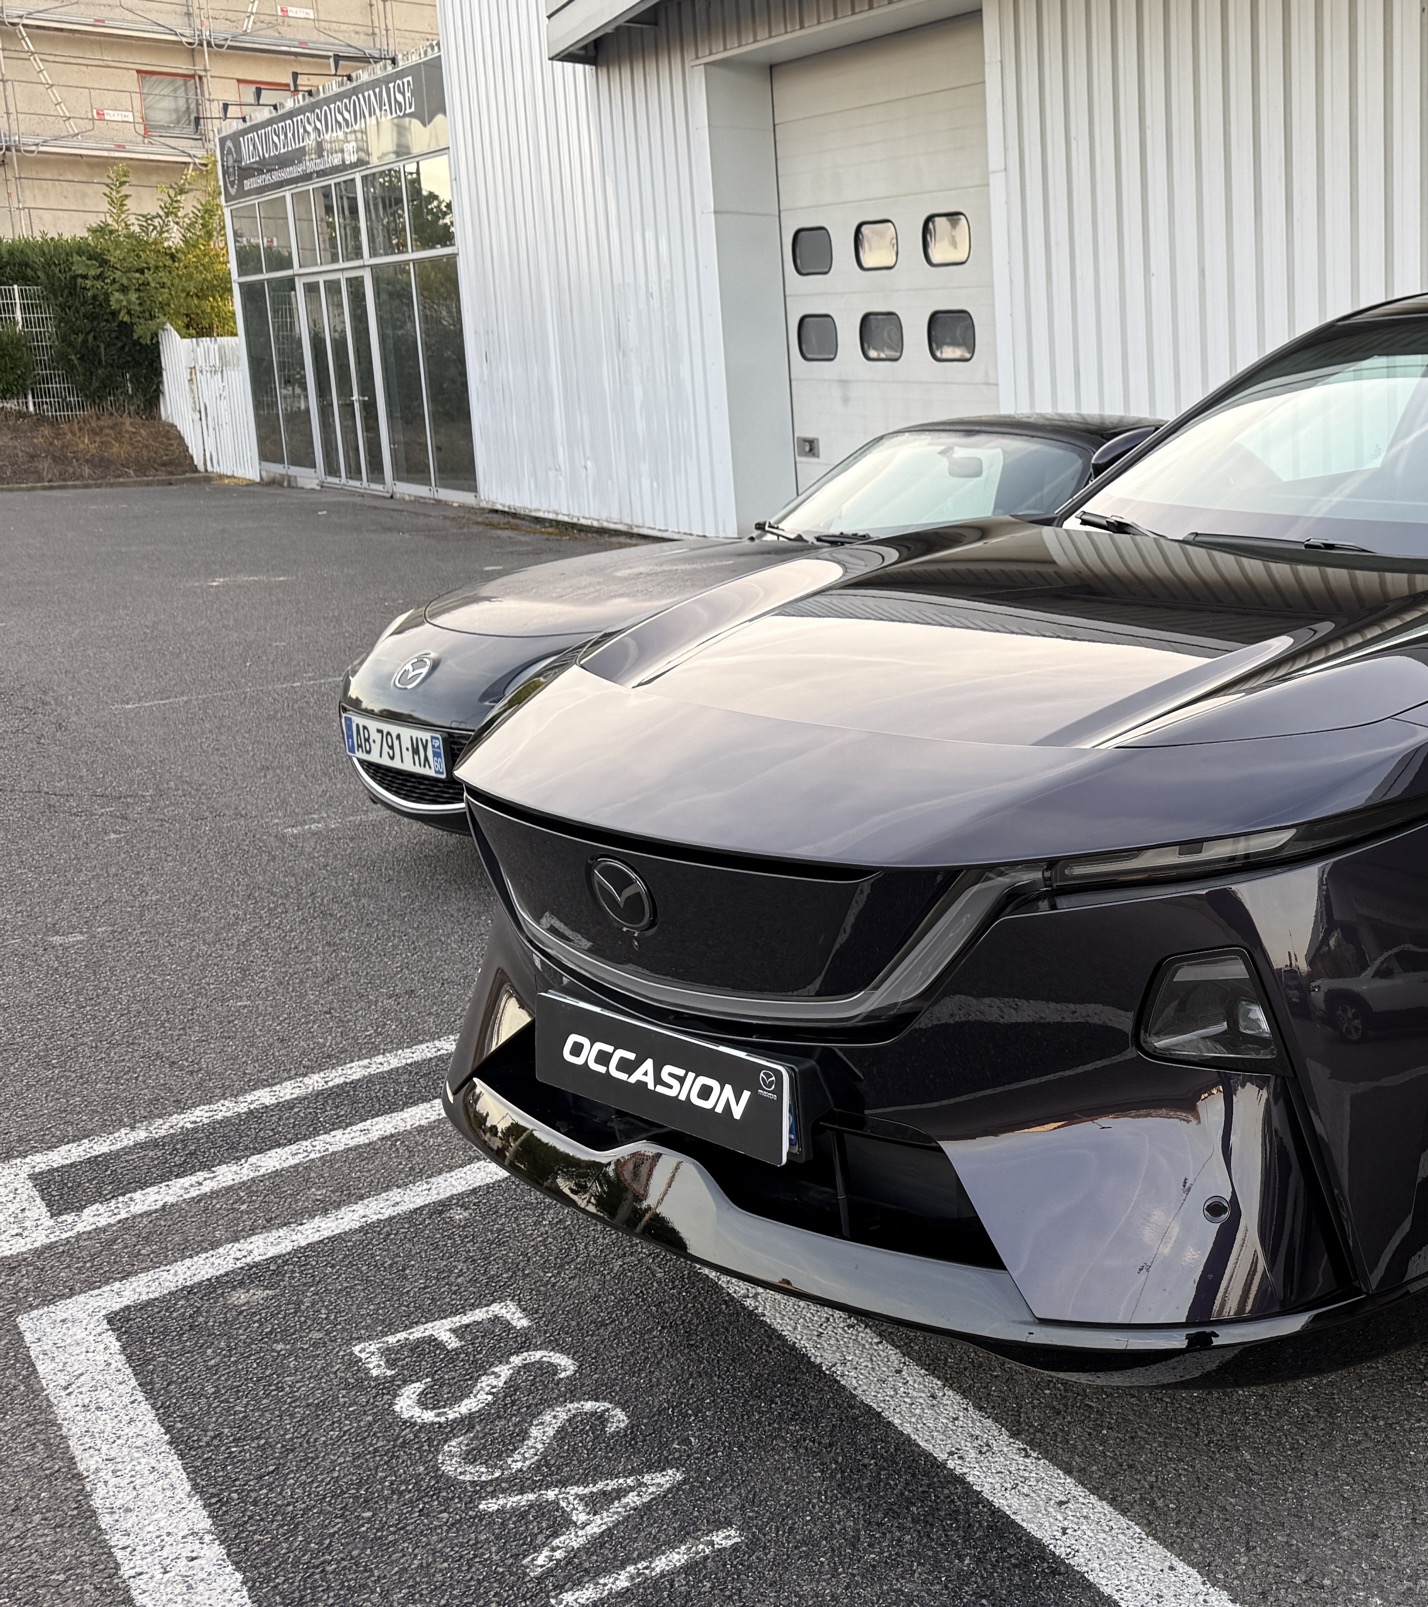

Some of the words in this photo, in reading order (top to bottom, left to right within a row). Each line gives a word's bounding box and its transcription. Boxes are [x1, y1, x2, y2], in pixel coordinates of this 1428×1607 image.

[239, 112, 314, 166] MENUISERIES
[314, 75, 415, 142] SOISSONNAISE
[433, 756, 443, 772] 60
[562, 1033, 751, 1120] OCCASION
[352, 1300, 744, 1607] ESSAI
